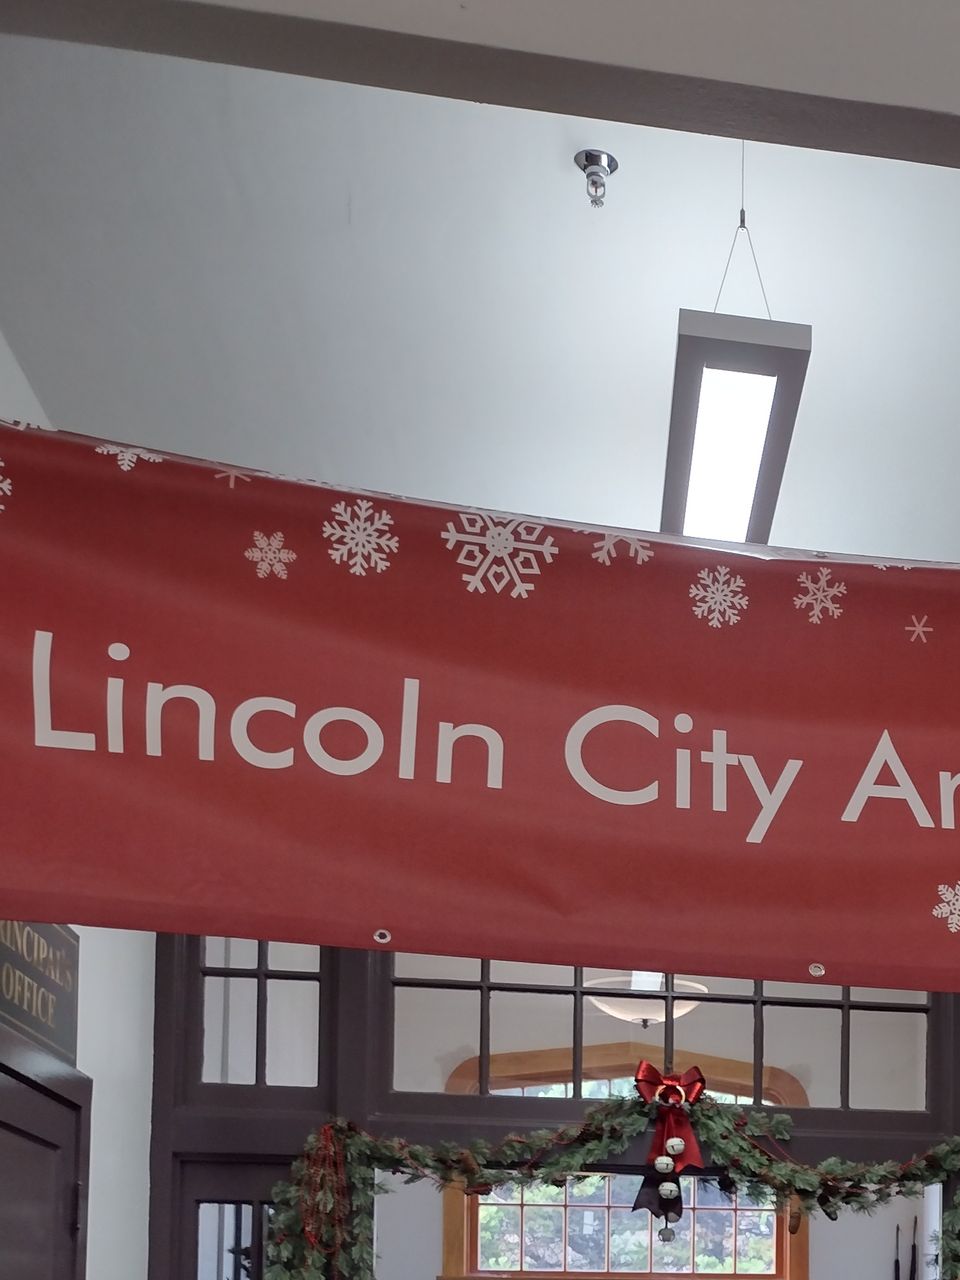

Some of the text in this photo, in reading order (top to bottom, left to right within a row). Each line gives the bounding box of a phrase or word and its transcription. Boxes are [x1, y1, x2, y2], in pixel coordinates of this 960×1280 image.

[32, 629, 505, 790] Lincoln
[565, 704, 803, 843] City
[2, 962, 57, 1027] OFFICE
